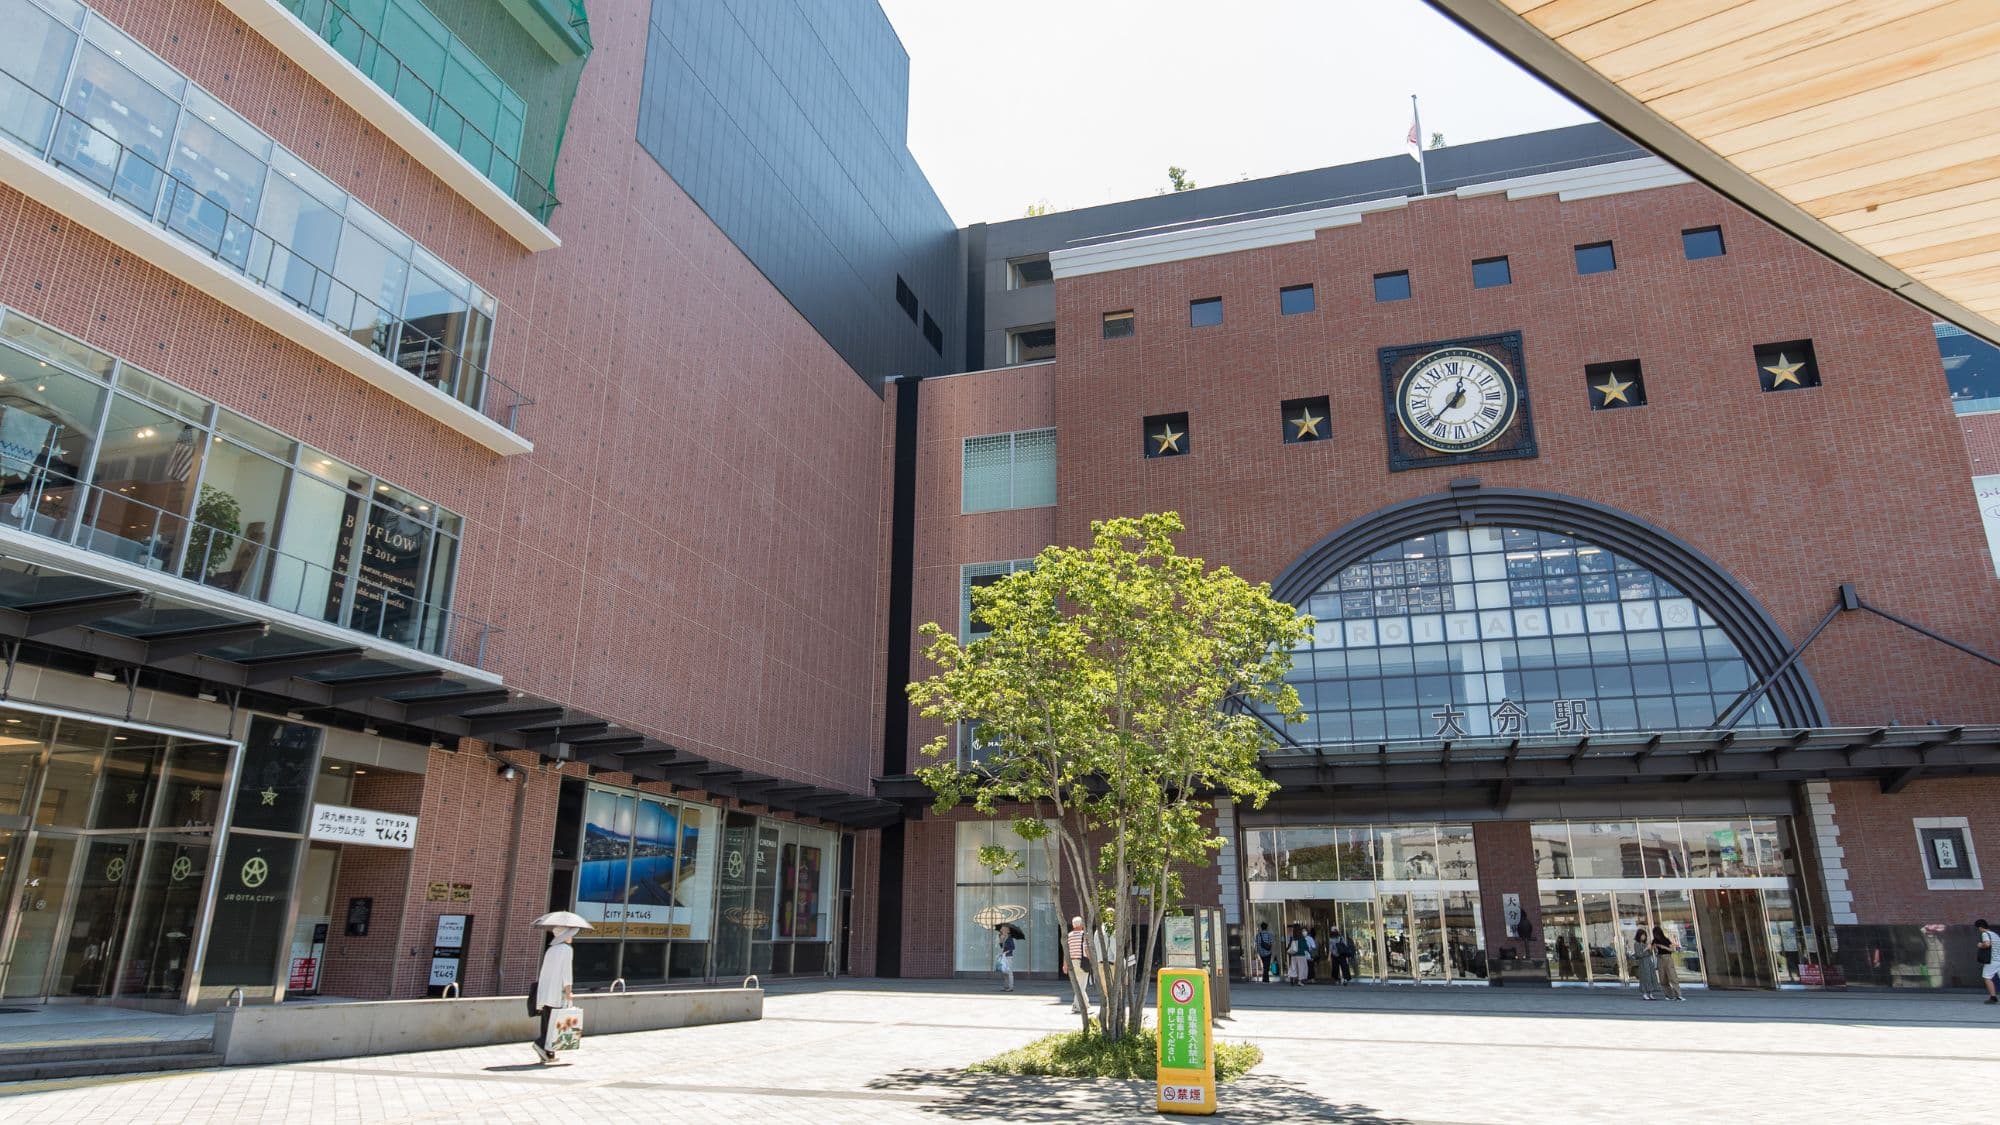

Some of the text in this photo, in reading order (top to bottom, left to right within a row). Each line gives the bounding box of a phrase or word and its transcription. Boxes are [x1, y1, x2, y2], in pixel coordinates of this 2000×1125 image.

[345, 514, 417, 552] BYFLOW
[375, 548, 397, 564] 2014
[1431, 698, 1593, 738] 大分駅
[320, 811, 367, 825] JR九州ホテル
[375, 818, 410, 828] CITY SPA
[318, 823, 365, 837] ブラッサム大分
[375, 828, 408, 842] てんくう
[1167, 1007, 1176, 1063] 押してください
[1176, 1088, 1201, 1101] 禁煙
